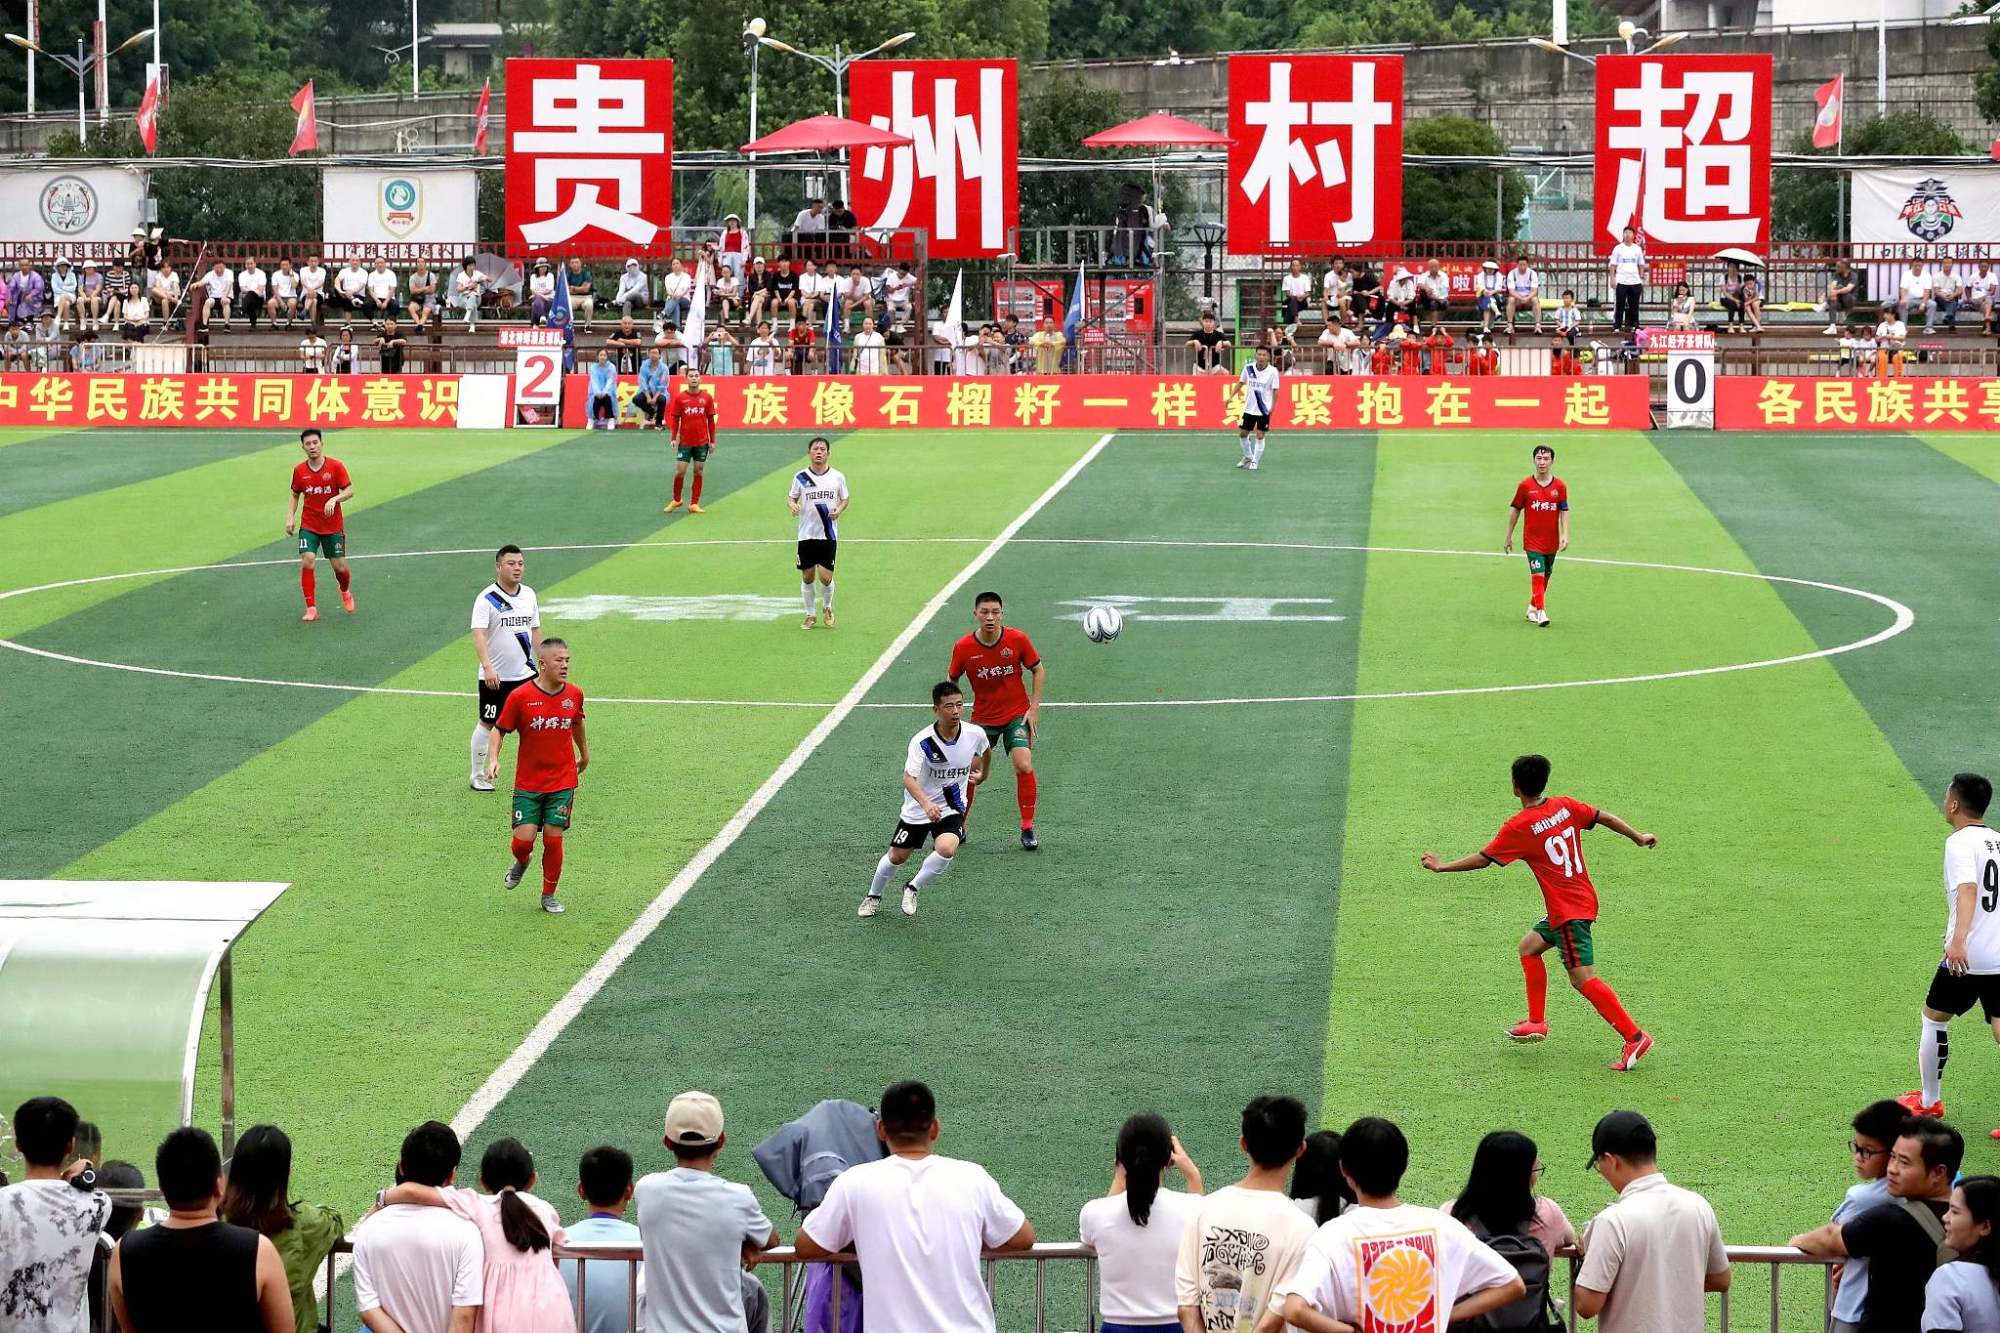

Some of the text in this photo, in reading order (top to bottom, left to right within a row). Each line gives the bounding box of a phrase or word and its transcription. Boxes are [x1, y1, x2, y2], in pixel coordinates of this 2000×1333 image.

[513, 62, 1760, 252] 贵 州 村 超
[522, 355, 554, 398] 2
[1675, 358, 1706, 404] 0
[484, 703, 497, 719] 29
[515, 810, 523, 821] 9
[893, 828, 909, 845] 19
[1544, 825, 1584, 879] 97
